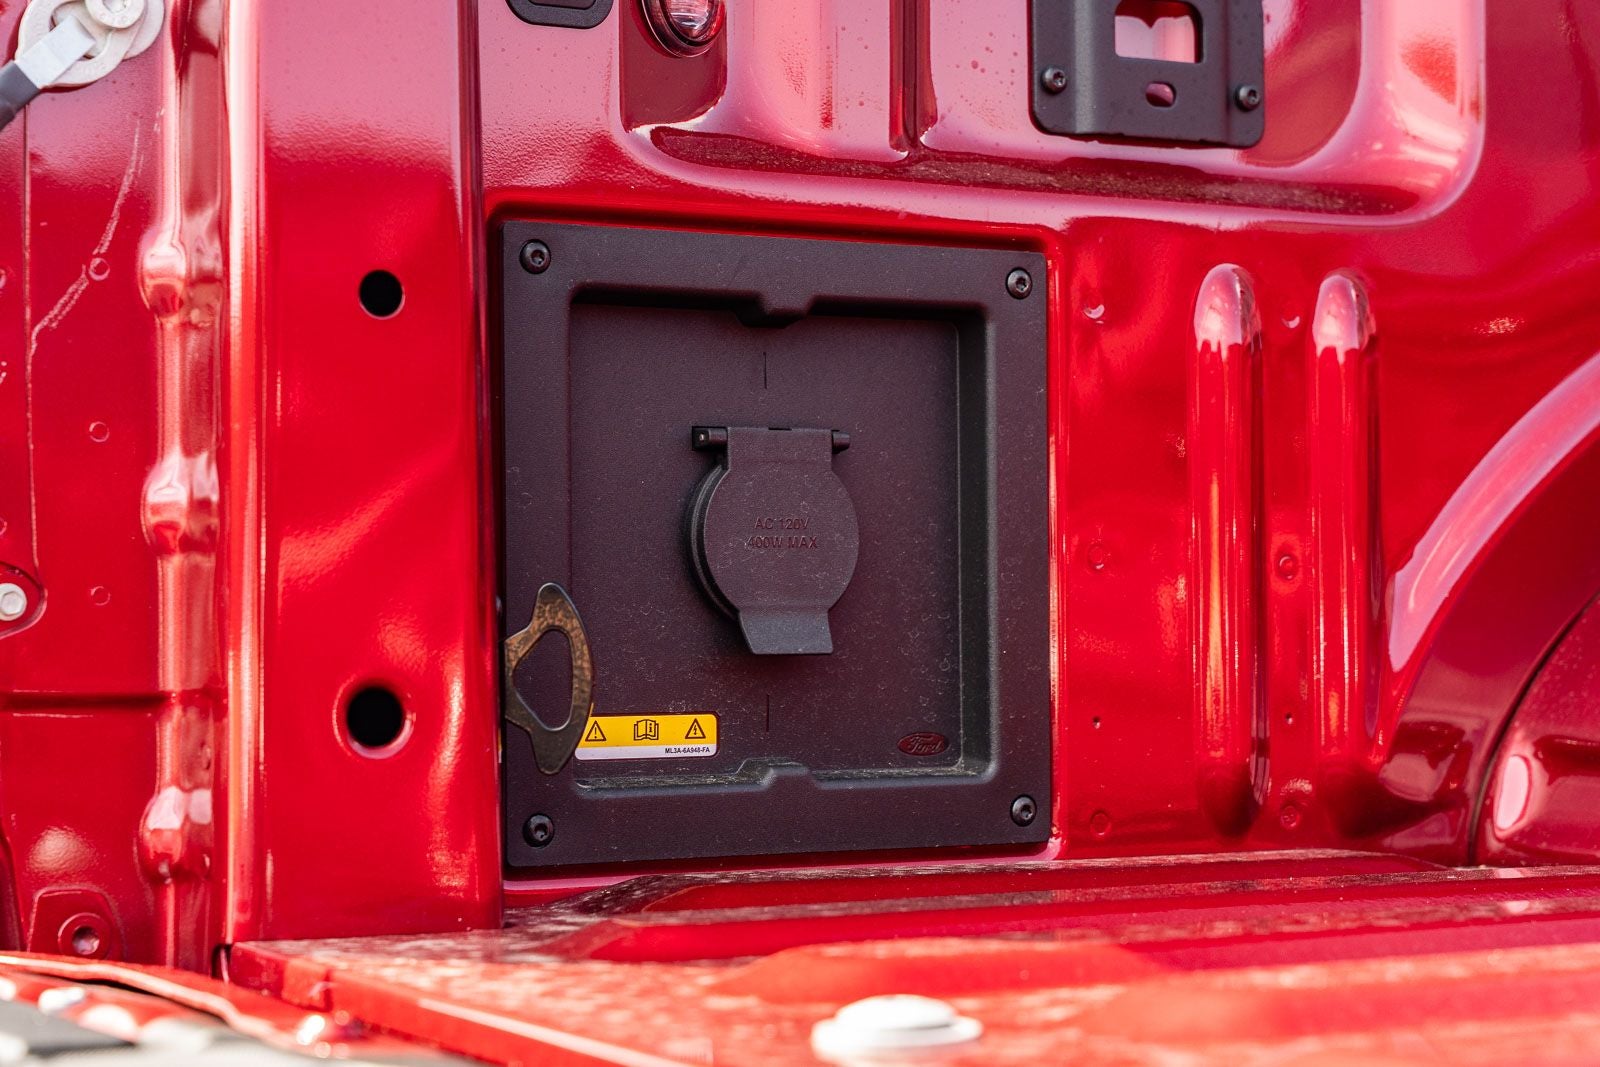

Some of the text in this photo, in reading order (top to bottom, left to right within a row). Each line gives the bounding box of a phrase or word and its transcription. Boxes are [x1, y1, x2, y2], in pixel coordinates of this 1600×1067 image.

[755, 517, 809, 529] AC 120V
[747, 535, 817, 548] 400W MAX
[908, 736, 942, 753] Ford
